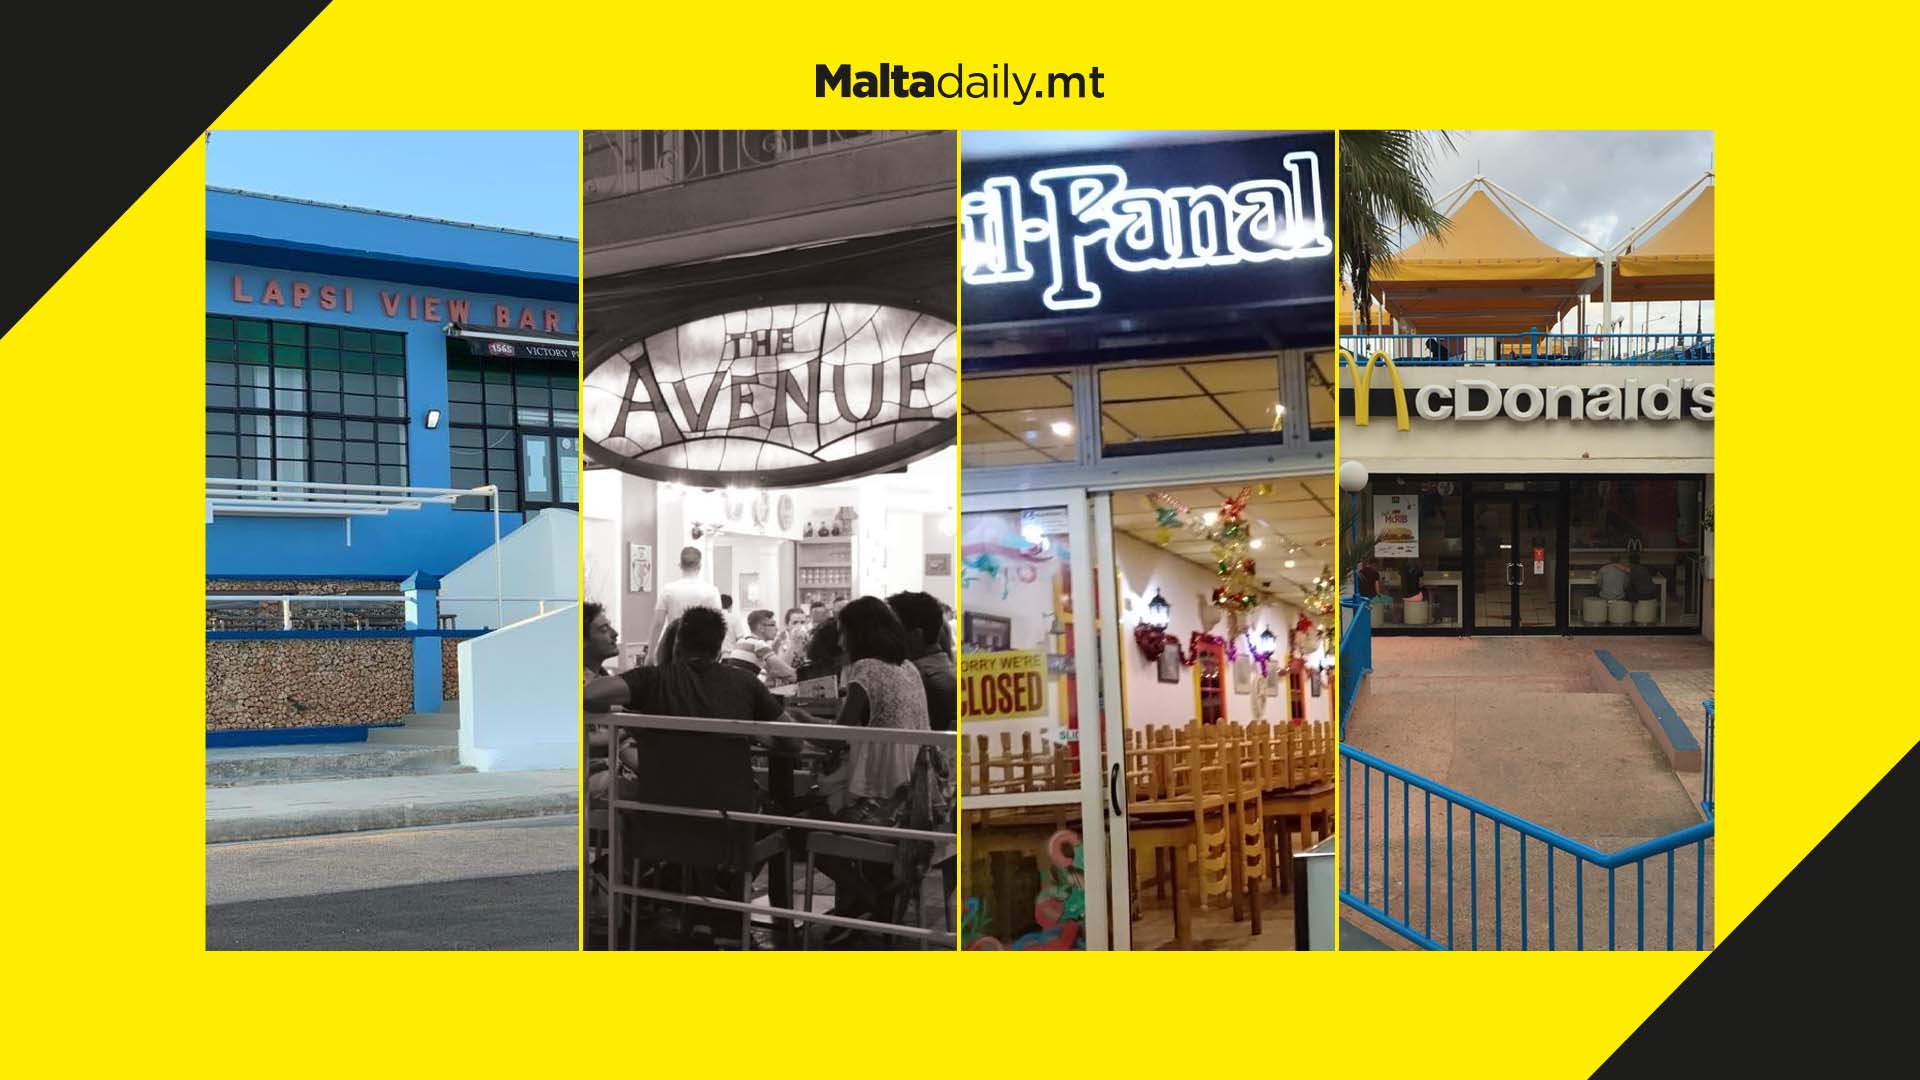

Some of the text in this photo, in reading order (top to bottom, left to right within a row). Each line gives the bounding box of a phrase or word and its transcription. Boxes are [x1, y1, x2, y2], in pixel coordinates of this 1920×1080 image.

[232, 276, 561, 332] LAPSI VIEW BAR
[491, 343, 514, 354] 1565
[526, 346, 569, 358] VICTORY
[726, 327, 795, 358] THE
[608, 348, 937, 445] AVENUE
